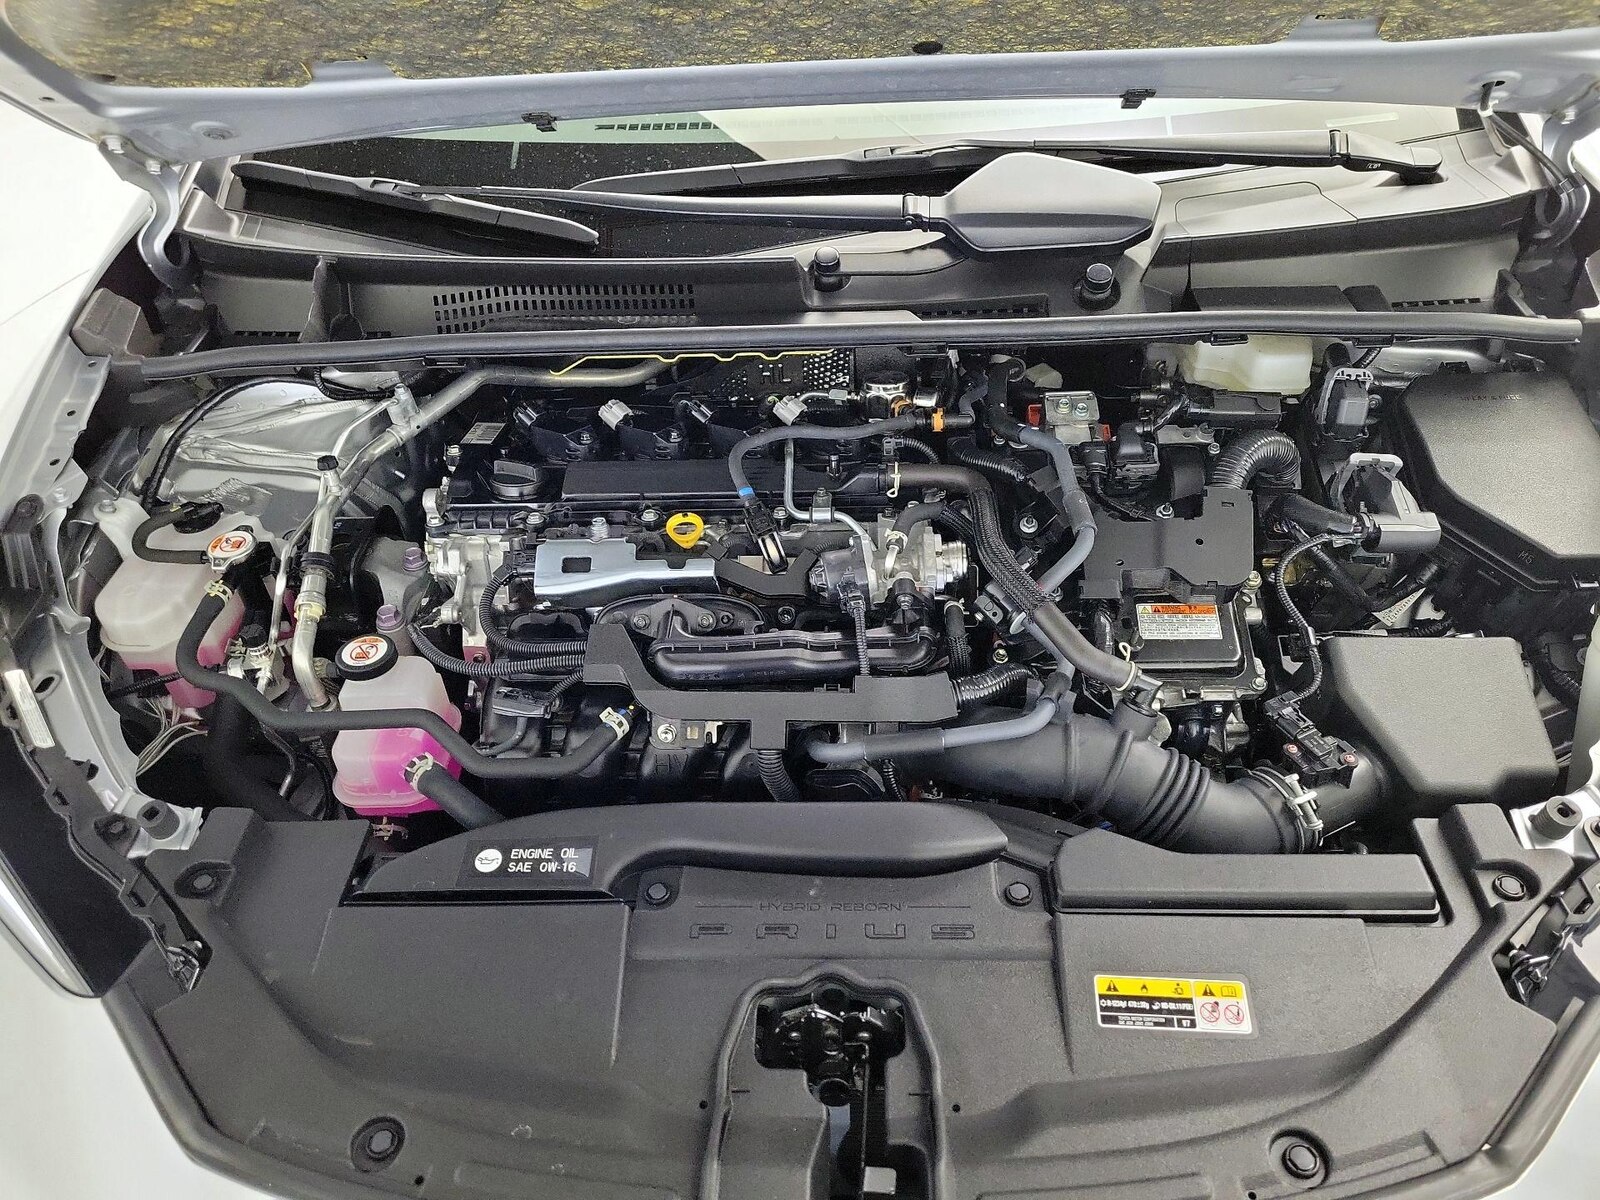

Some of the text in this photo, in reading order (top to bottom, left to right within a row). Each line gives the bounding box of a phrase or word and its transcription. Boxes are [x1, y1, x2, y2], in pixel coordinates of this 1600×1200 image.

[510, 848, 579, 859] ENGINE OIL
[507, 862, 577, 873] SAE 0W-16
[759, 902, 821, 911] HYBRID
[690, 923, 976, 940] PRIUS
